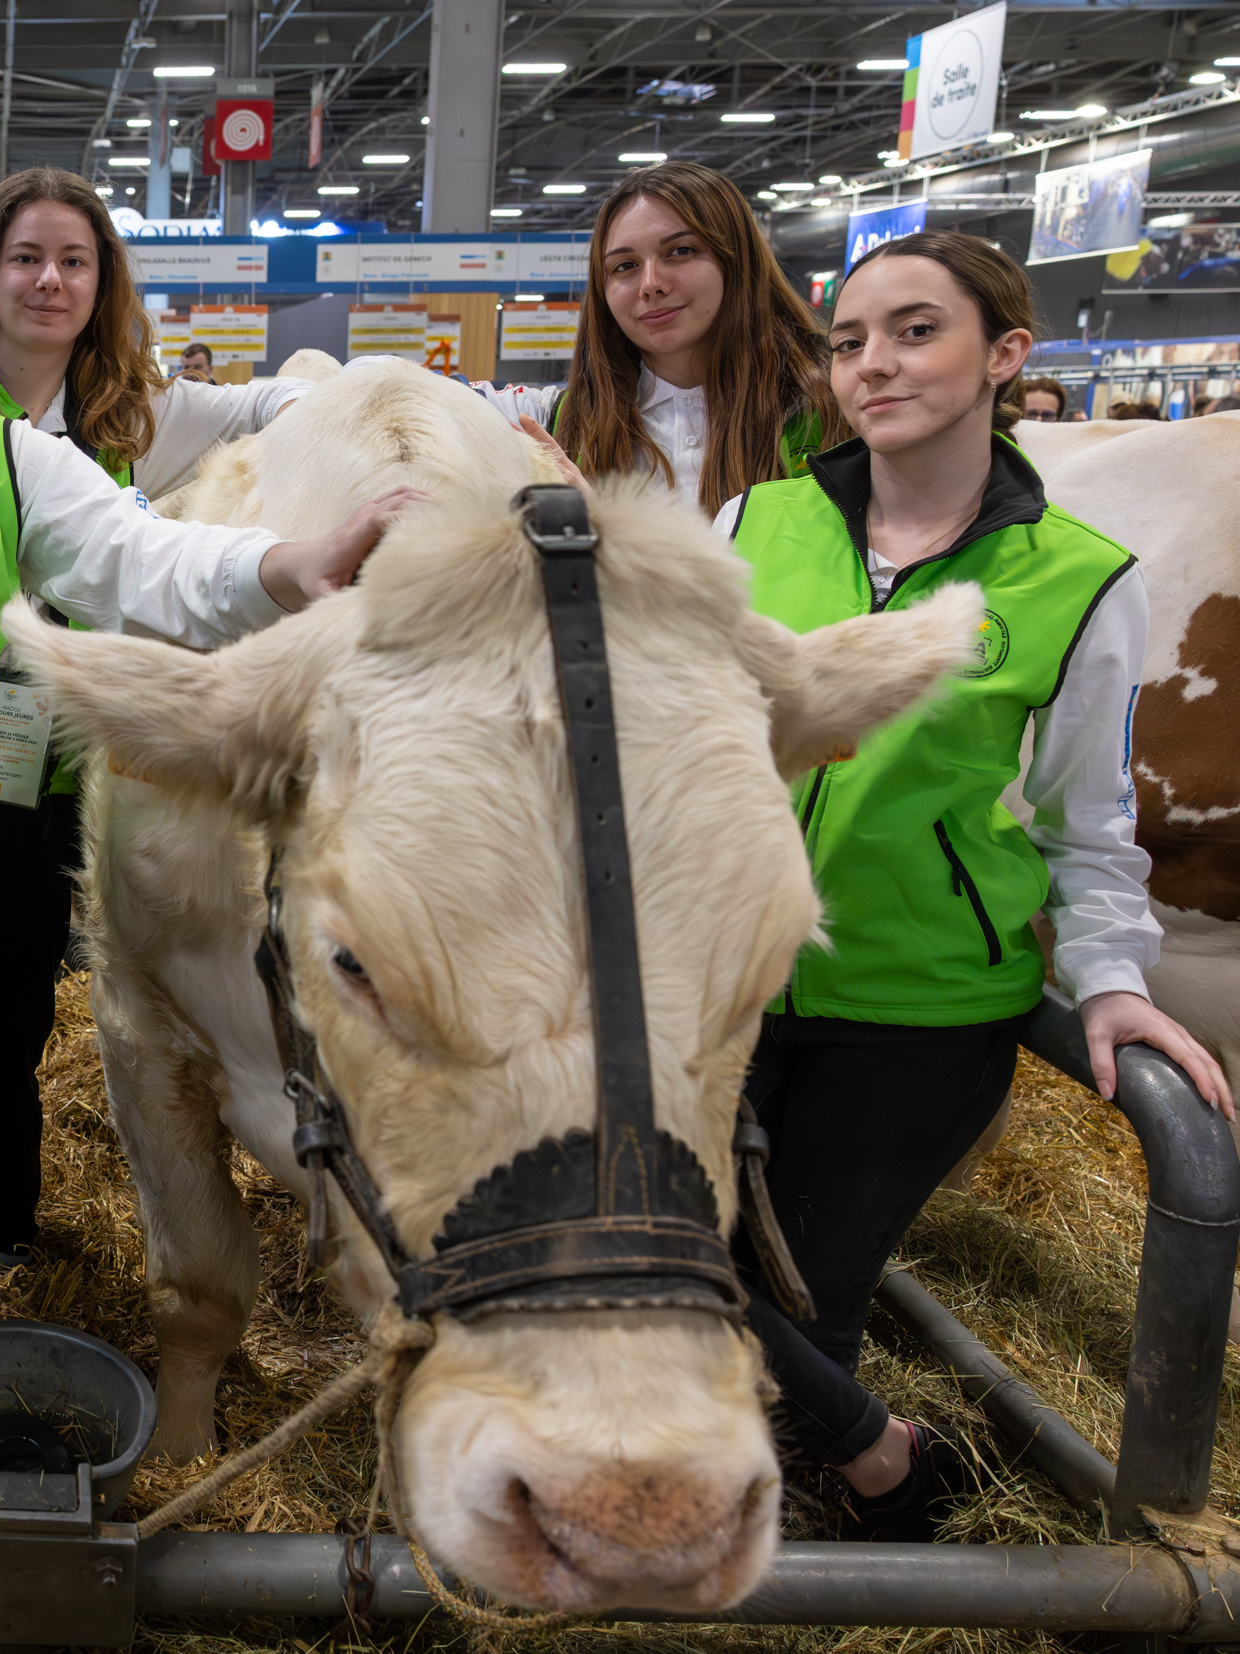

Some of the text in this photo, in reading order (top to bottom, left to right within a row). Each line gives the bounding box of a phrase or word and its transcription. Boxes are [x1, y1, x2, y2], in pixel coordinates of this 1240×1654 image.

[943, 63, 969, 85] Salle
[931, 82, 977, 109] de traite
